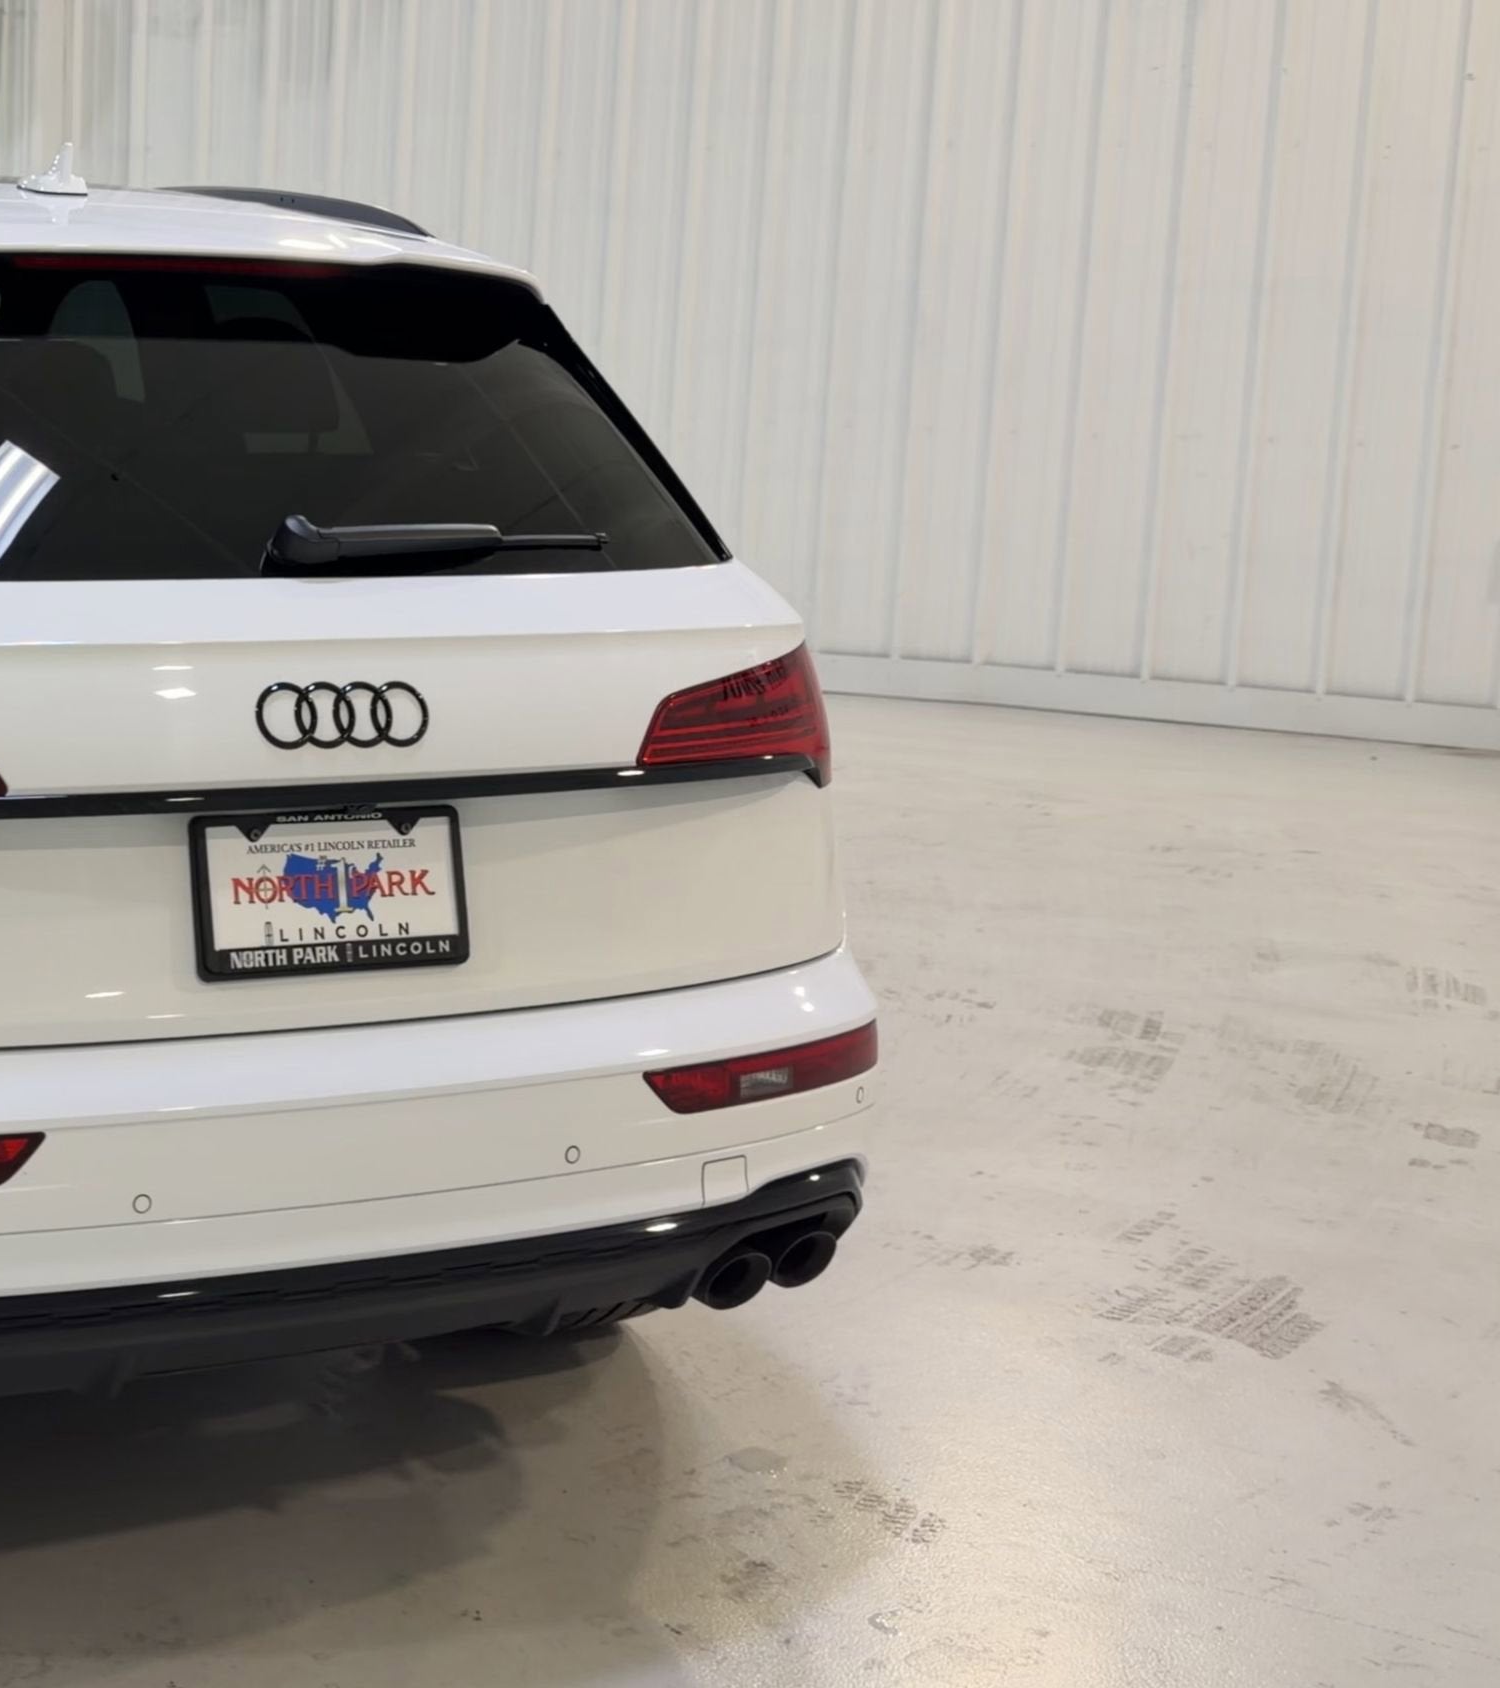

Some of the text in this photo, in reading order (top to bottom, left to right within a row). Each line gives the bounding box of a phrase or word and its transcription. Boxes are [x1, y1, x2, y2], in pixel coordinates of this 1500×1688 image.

[276, 815, 309, 823] SAN
[247, 838, 416, 855] AMERICA'S #1 LINCOLN RETAILER
[231, 869, 436, 906] NORTH PARK
[279, 922, 411, 943] LINCOLN
[230, 939, 450, 970] NORTH PARK LINCOLN
